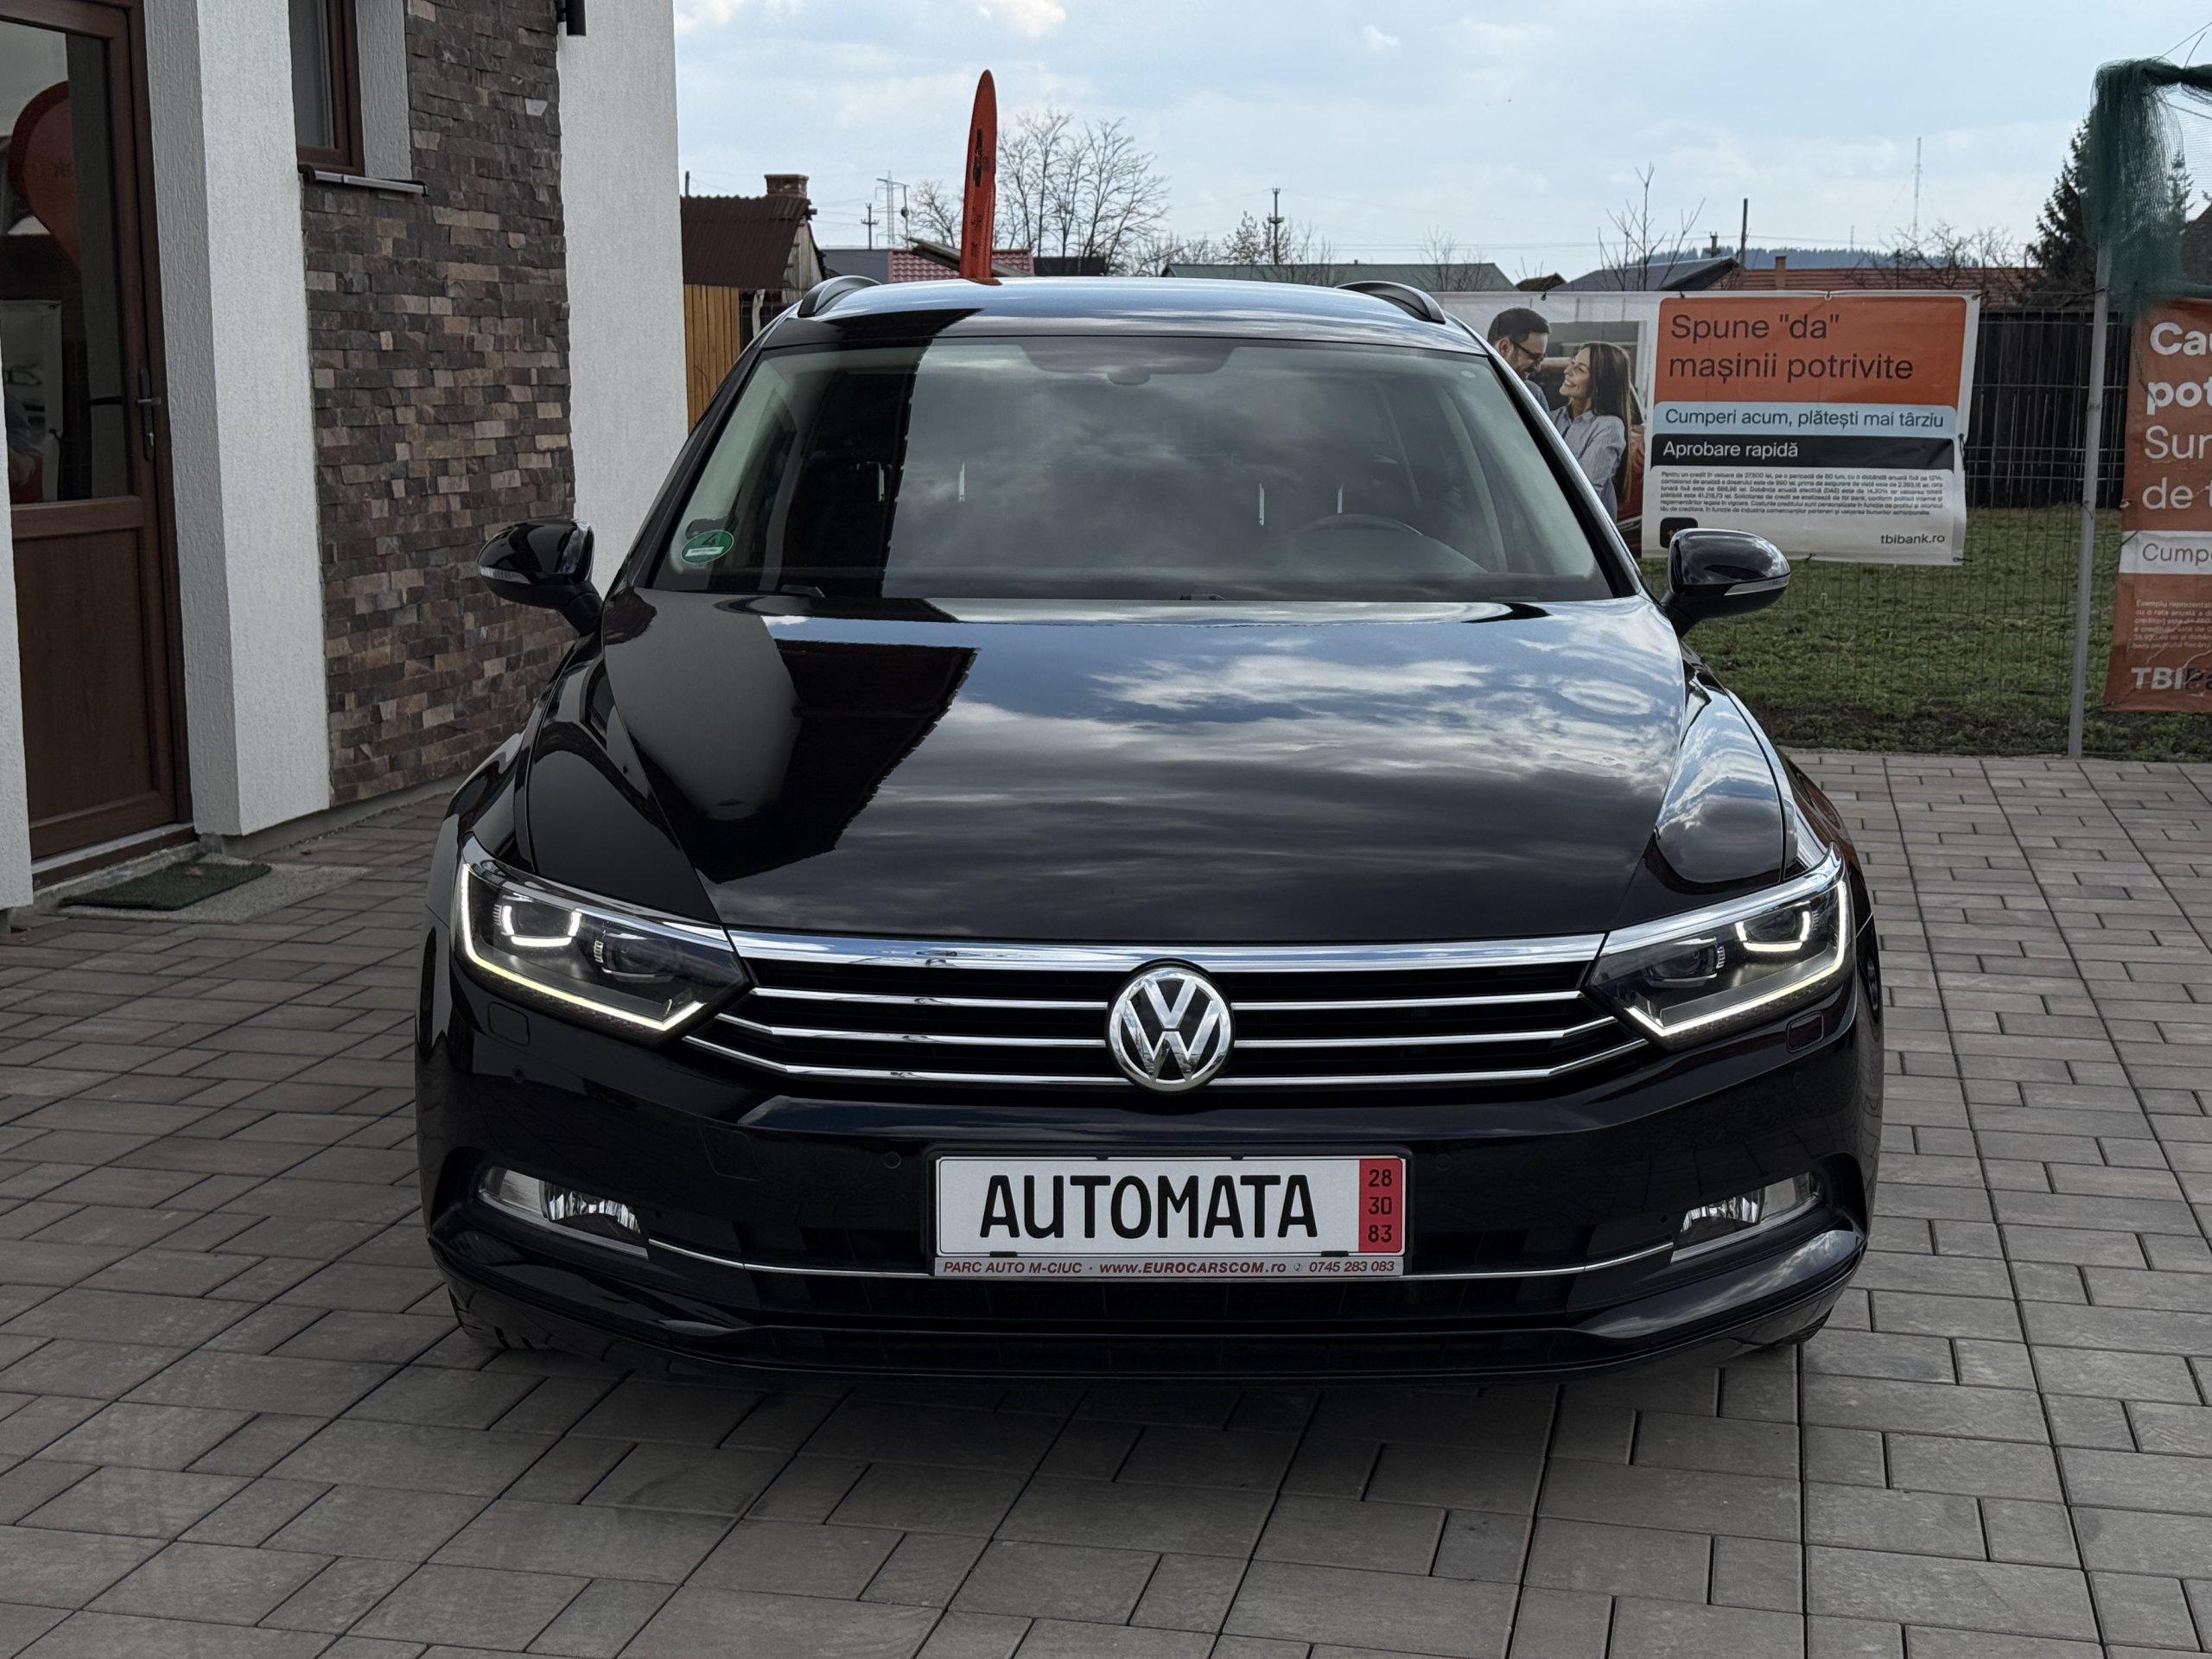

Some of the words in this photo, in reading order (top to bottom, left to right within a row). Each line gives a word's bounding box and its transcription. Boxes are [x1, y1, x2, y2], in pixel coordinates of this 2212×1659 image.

[1670, 314, 1770, 344] Spune
[1779, 313, 1840, 340] "da"
[2150, 321, 2212, 356] Ca
[1669, 353, 1777, 385] mașinii
[1786, 353, 1913, 383] potrivite
[1665, 409, 1737, 427] Cumperi
[1741, 411, 1793, 428] acum,
[1797, 410, 1859, 429] plătești
[1863, 411, 1894, 426] mai
[1899, 411, 1944, 428] târziu
[1662, 441, 1741, 459] Aprobare
[1745, 442, 1798, 461] rapidă
[2142, 477, 2193, 510] de
[1880, 533, 1945, 544] tbibank.ro
[2142, 543, 2212, 567] Cump
[1368, 1169, 1393, 1187] 28
[979, 1174, 1319, 1239] AUTOMATA
[1368, 1197, 1393, 1215] 30
[1368, 1224, 1393, 1243] 83
[944, 1262, 982, 1273] PARC
[985, 1262, 1026, 1273] AUTO
[1028, 1262, 1083, 1274] M-CIUC
[1099, 1262, 1287, 1274] www.EUROCARSCOM.ro
[1309, 1261, 1341, 1273] 0745
[1344, 1261, 1368, 1272] 283
[1370, 1261, 1395, 1272] 083
